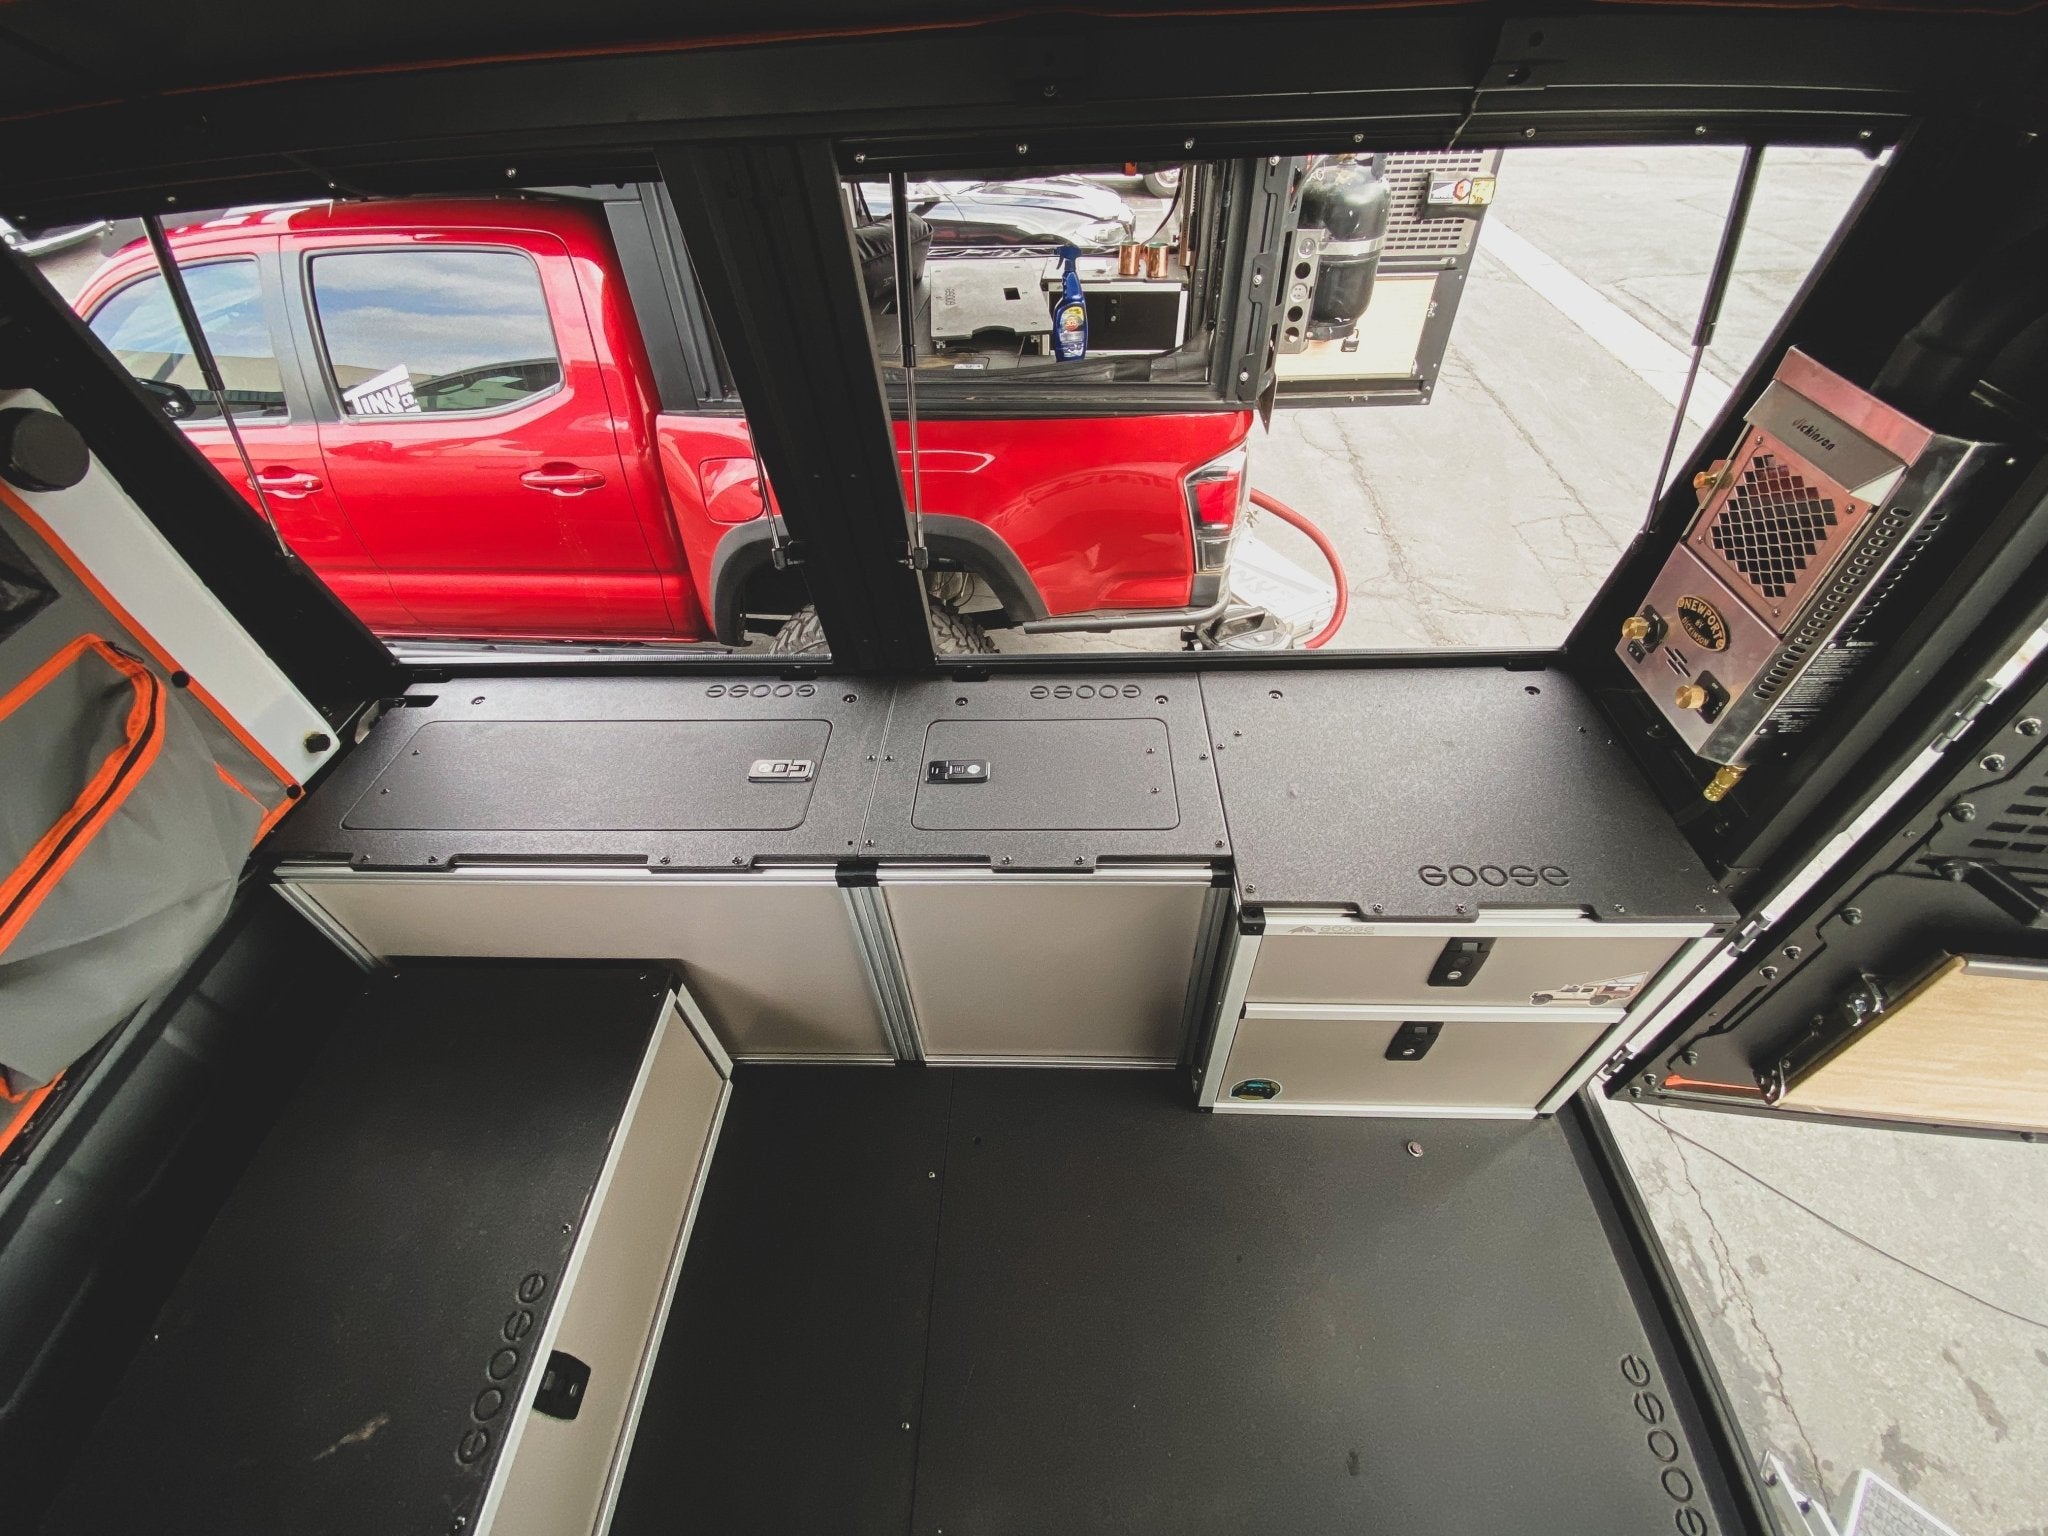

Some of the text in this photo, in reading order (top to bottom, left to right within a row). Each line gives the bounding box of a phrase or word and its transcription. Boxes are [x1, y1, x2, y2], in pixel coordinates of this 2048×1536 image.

[343, 364, 409, 415] TINY
[1681, 616, 1710, 647] DICKINSON
[1683, 598, 1723, 639] NEWPORT
